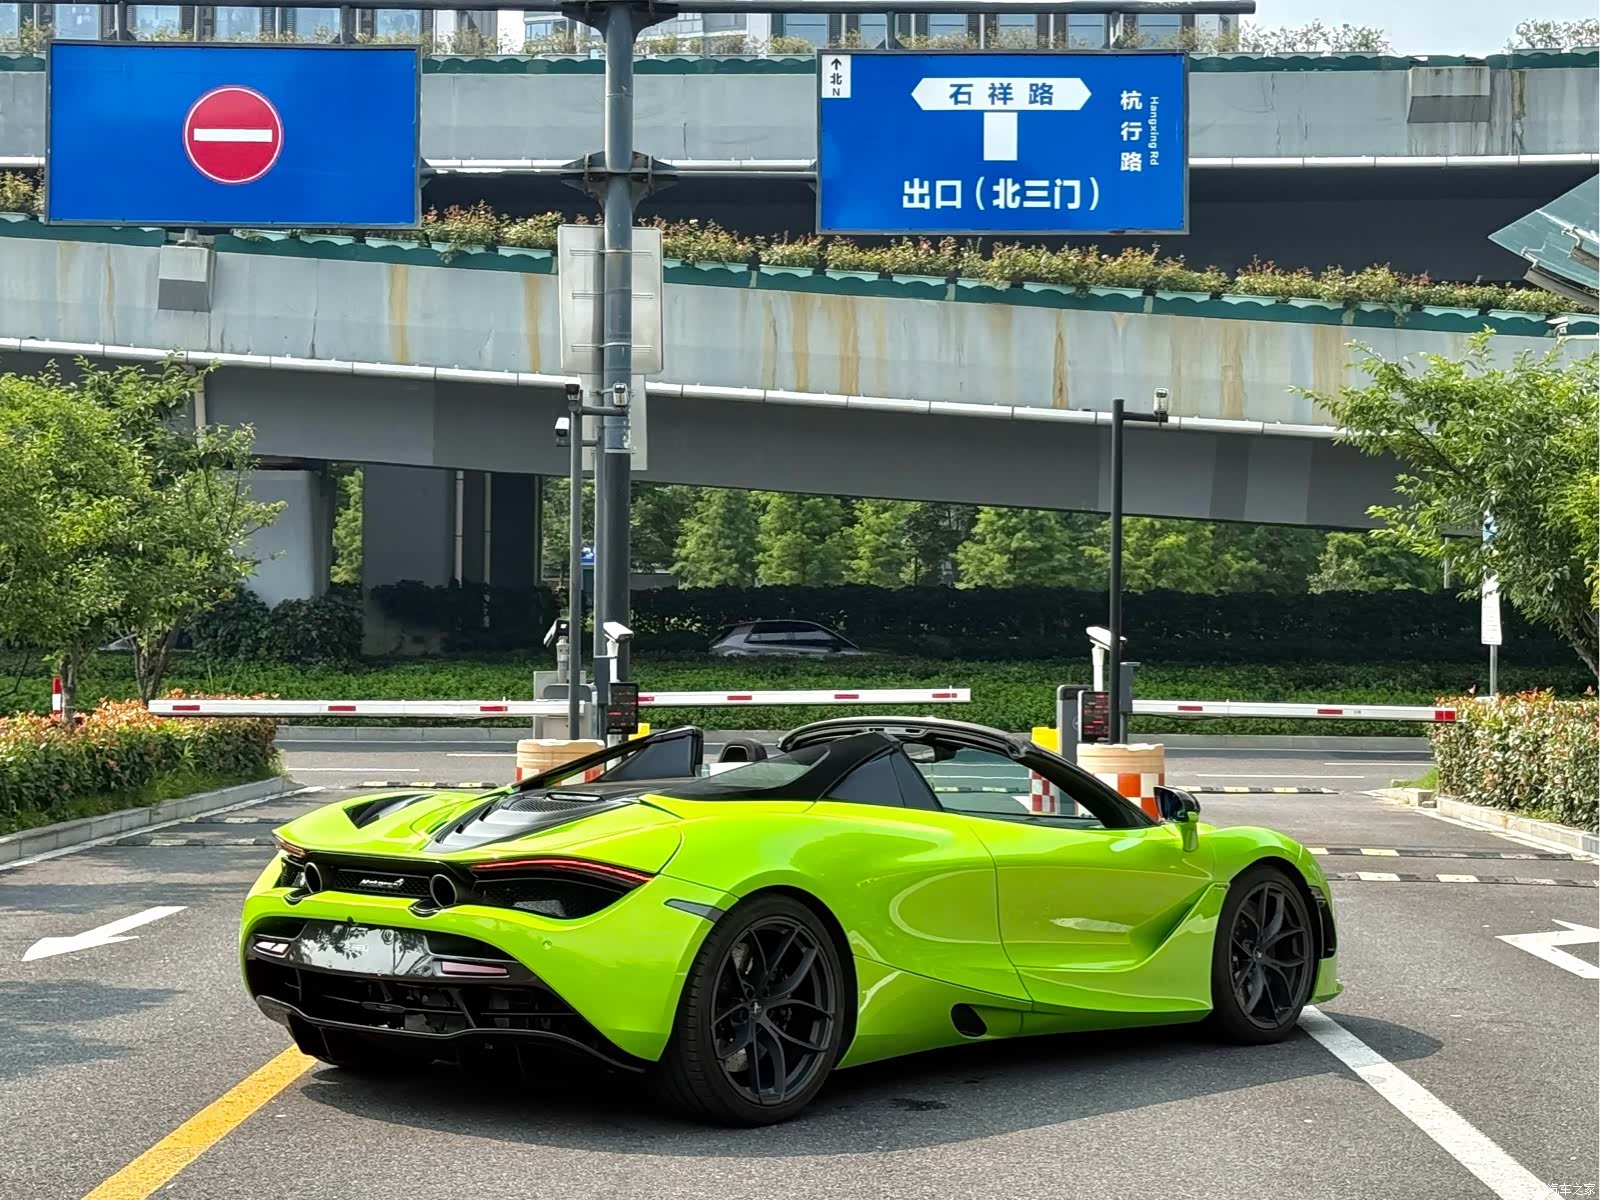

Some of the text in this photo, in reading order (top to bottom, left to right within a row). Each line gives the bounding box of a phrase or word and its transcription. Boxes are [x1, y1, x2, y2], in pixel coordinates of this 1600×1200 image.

[829, 72, 842, 86] 北
[832, 88, 841, 97] N
[949, 82, 1055, 106] 石祥路
[1120, 90, 1142, 172] 杭行路
[1147, 96, 1159, 166] Hangxing Rd
